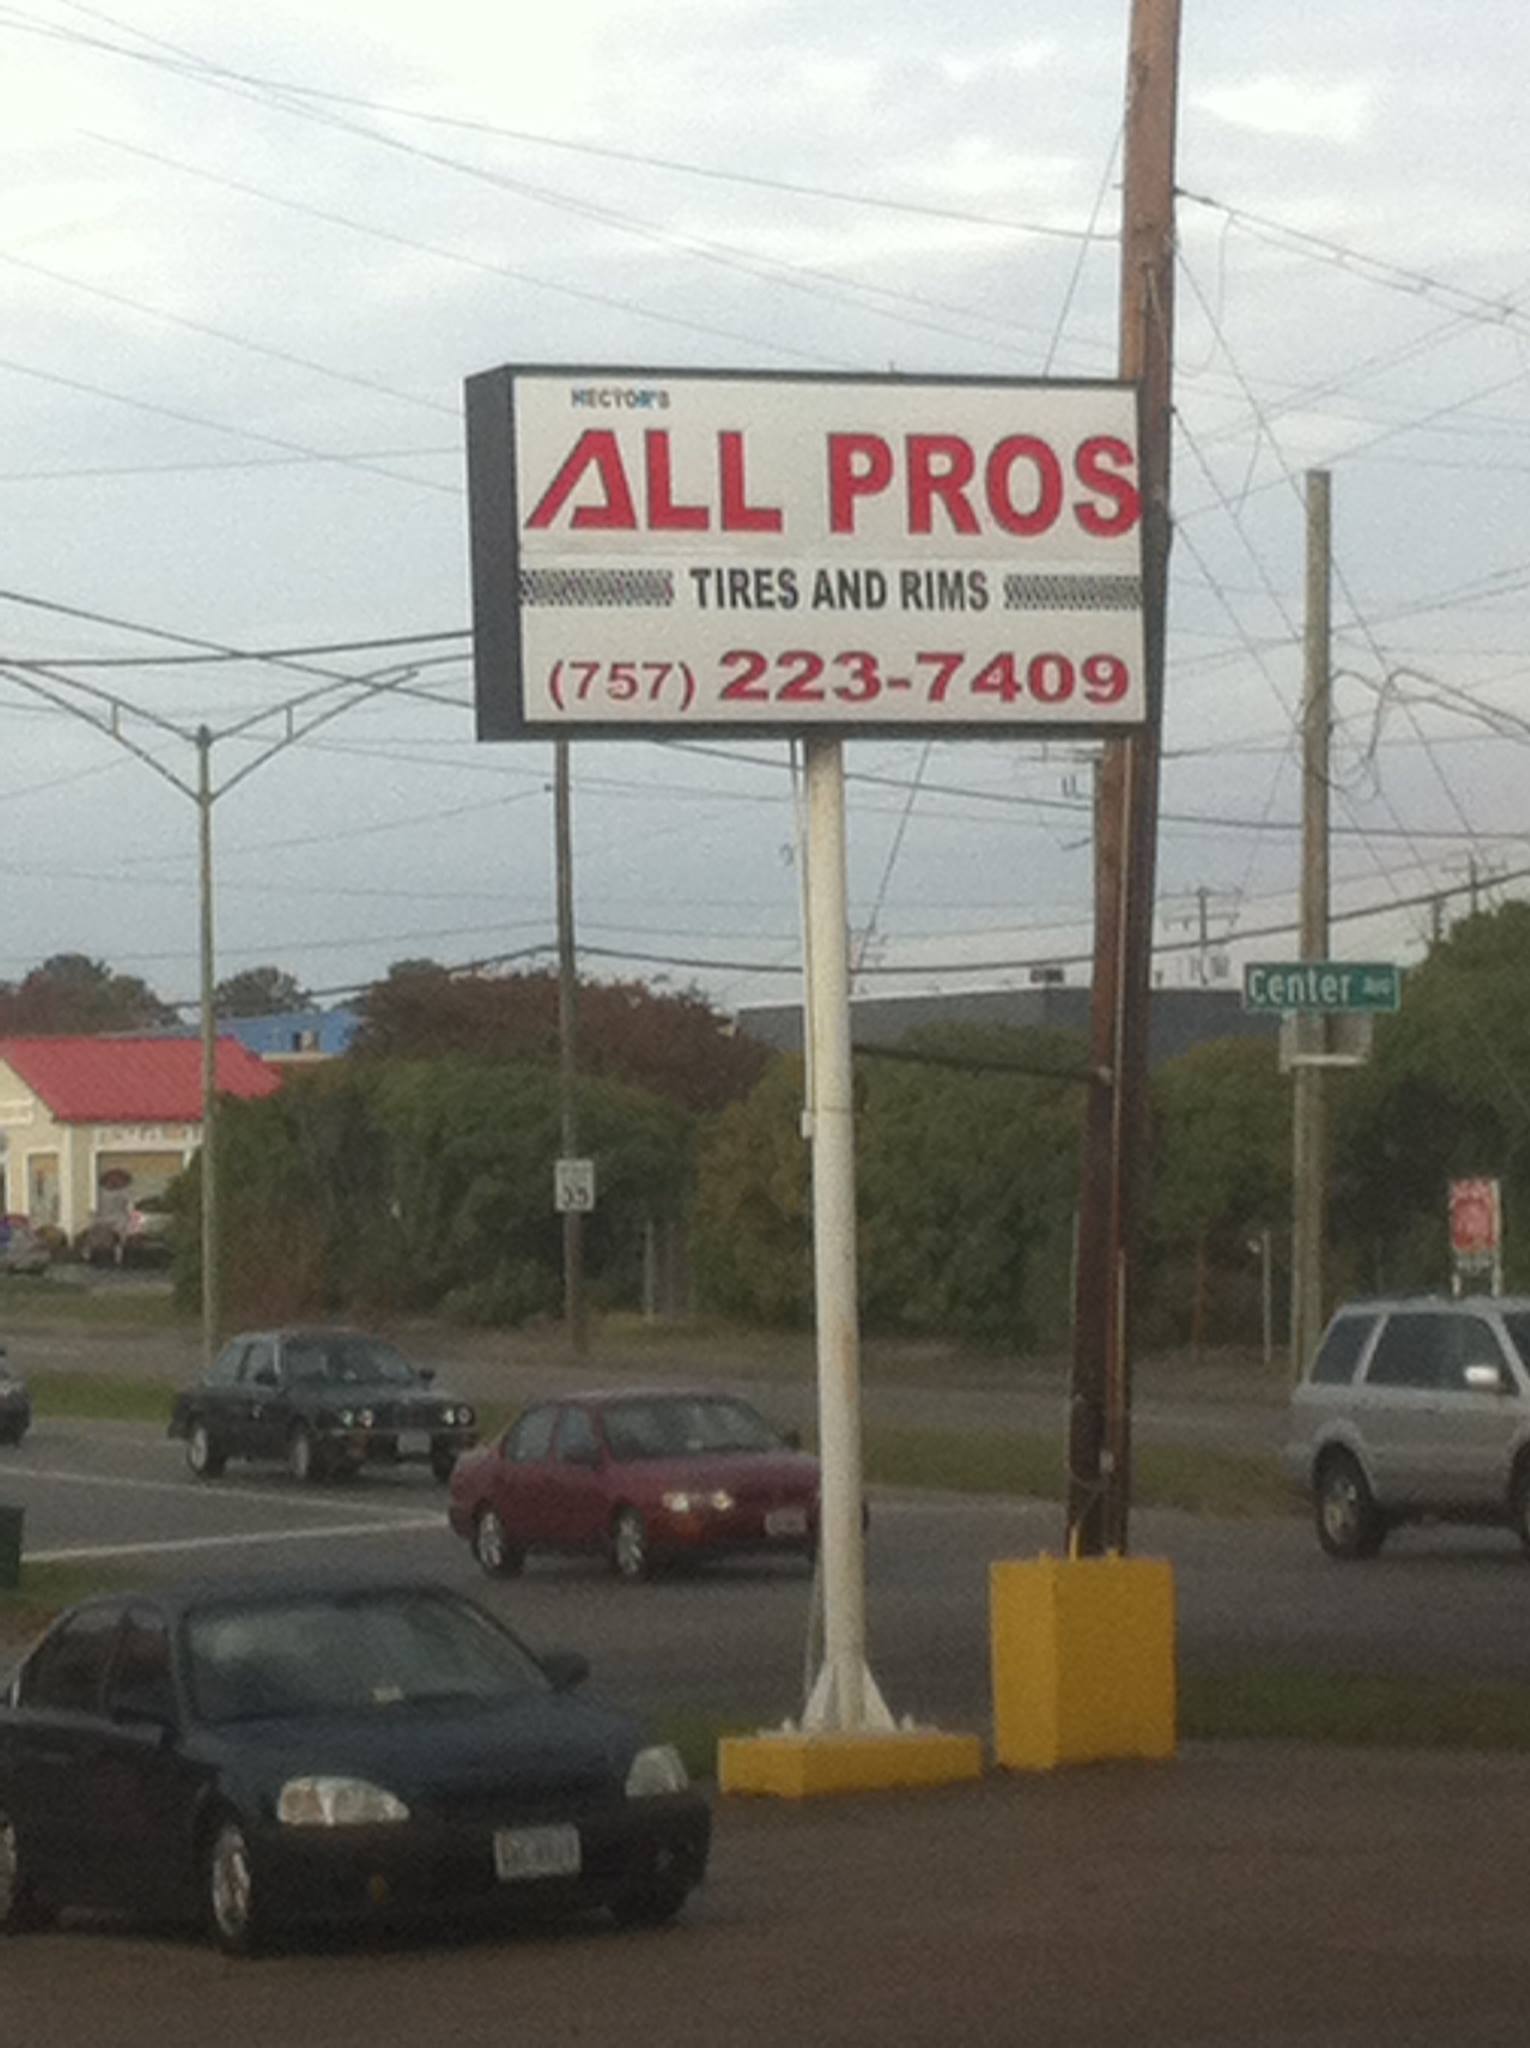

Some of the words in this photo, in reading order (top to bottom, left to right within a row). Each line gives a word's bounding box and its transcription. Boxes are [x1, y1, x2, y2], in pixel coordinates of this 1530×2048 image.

[524, 429, 784, 532] ALL
[827, 432, 1143, 537] PROS
[690, 567, 799, 610] TIRES
[811, 568, 887, 611] AND
[900, 569, 990, 612] RIMS
[549, 660, 695, 709] (757)
[718, 650, 1129, 703] 223-7409
[1249, 968, 1350, 1003] Center
